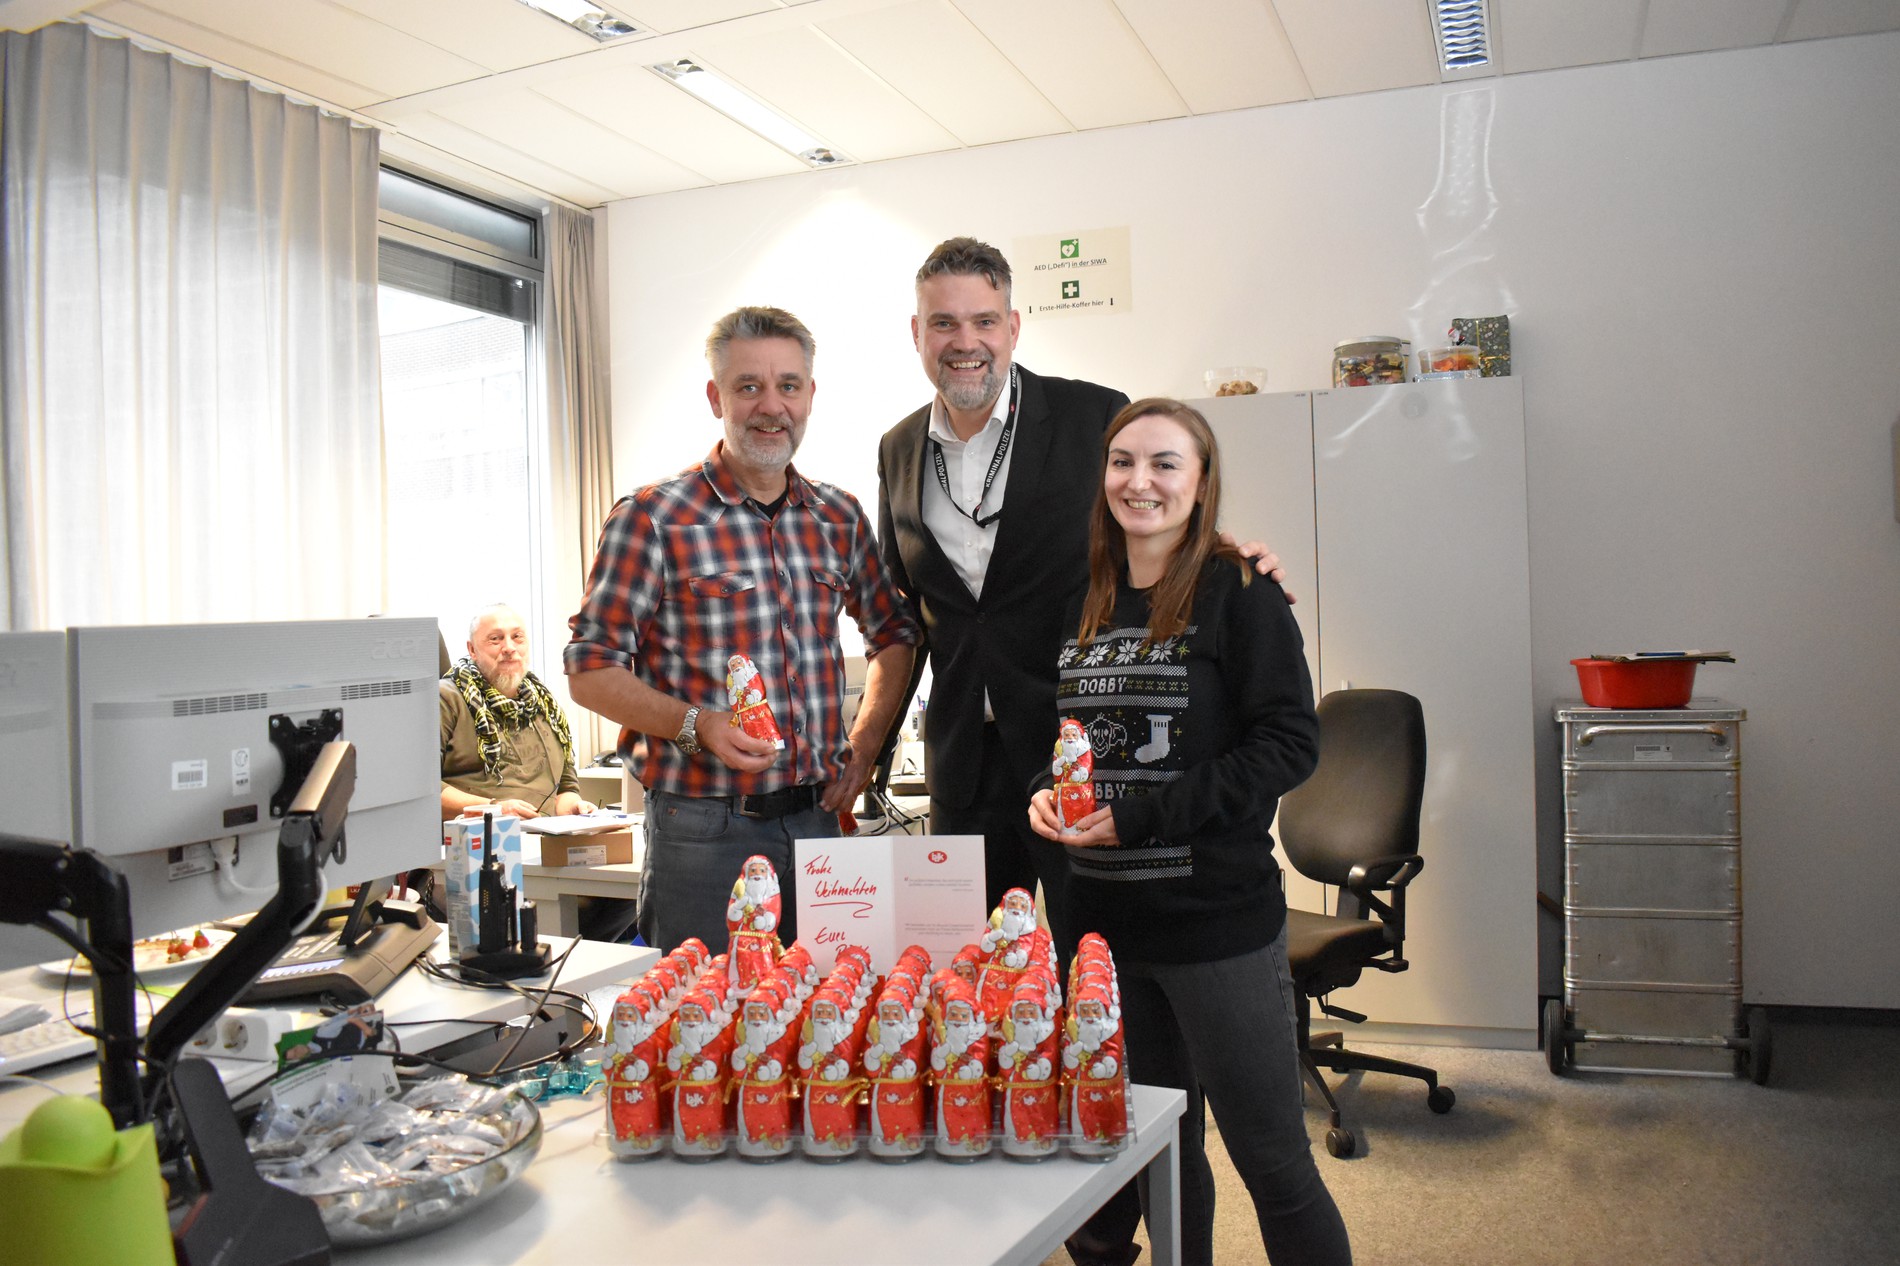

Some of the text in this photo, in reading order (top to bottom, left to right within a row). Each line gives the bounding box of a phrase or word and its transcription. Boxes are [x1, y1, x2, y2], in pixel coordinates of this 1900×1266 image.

[1090, 257, 1107, 265] SIWA
[1039, 299, 1104, 312] Erste-Hilfe-Koffer hier
[985, 429, 1010, 488] KRIMINALPOLIZEI
[1078, 677, 1127, 694] DOBBY
[1095, 783, 1127, 799] BBY
[814, 876, 877, 898] Weihnachten
